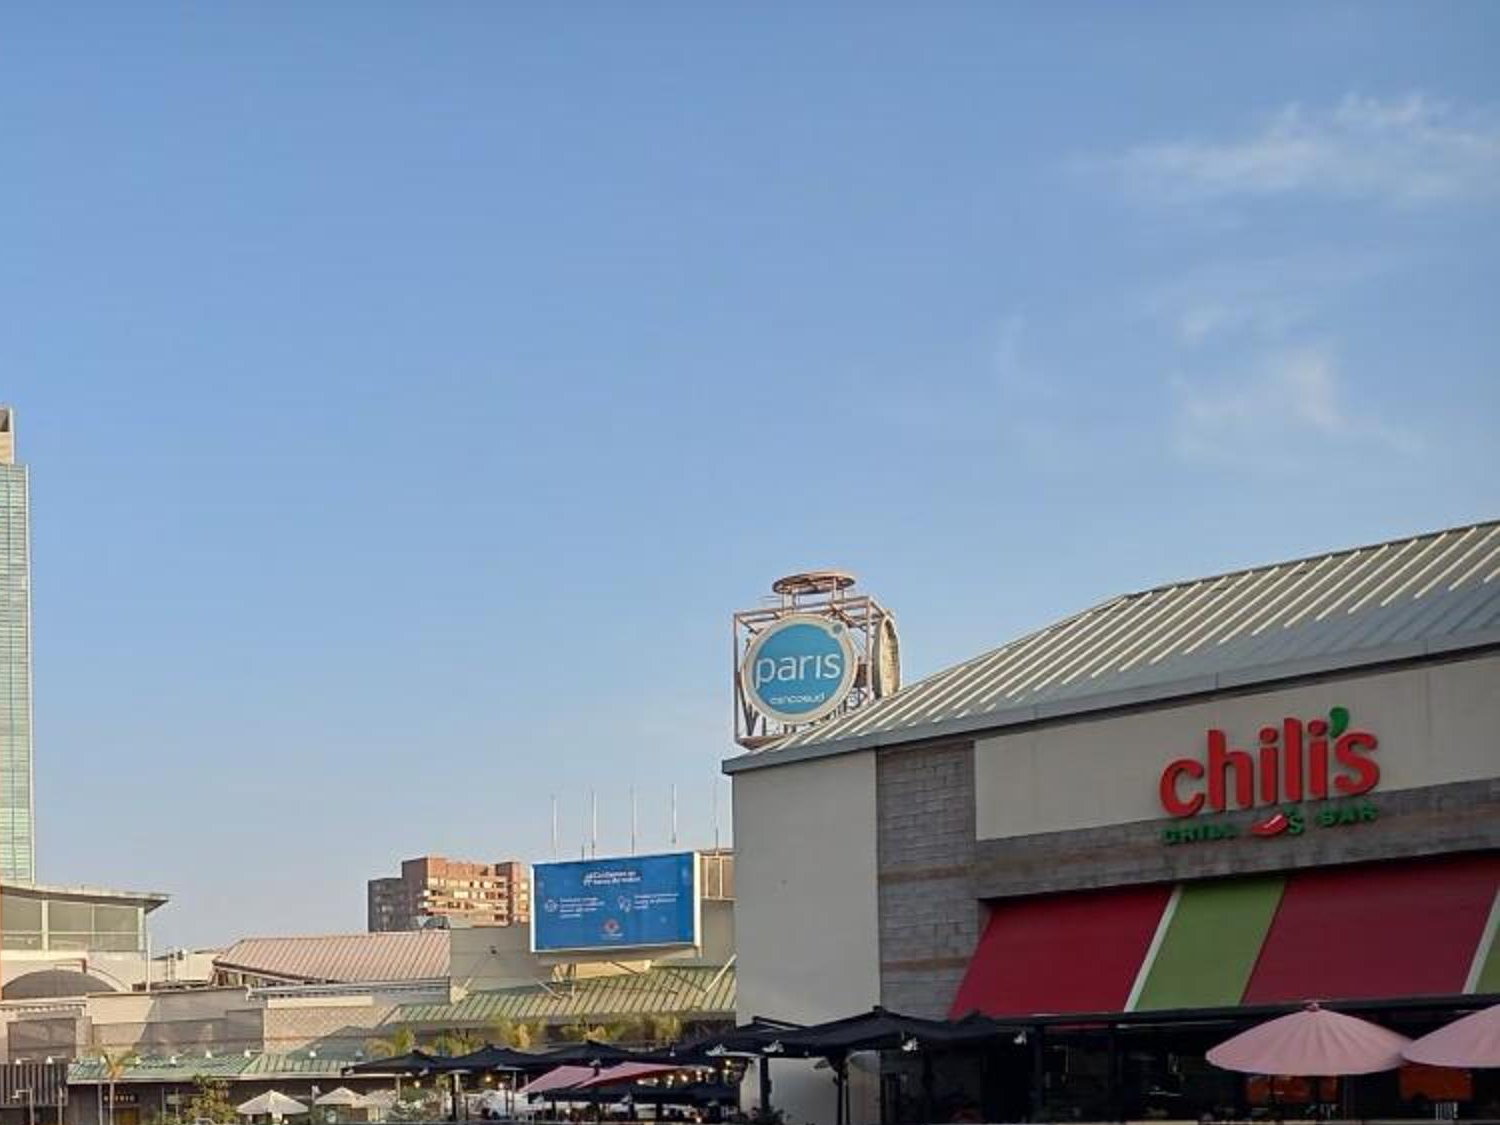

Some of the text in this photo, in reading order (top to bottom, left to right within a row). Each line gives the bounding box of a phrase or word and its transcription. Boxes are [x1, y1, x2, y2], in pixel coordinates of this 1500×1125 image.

[756, 653, 841, 690] paris
[1160, 707, 1381, 818] chili's
[1315, 799, 1380, 828] BAR
